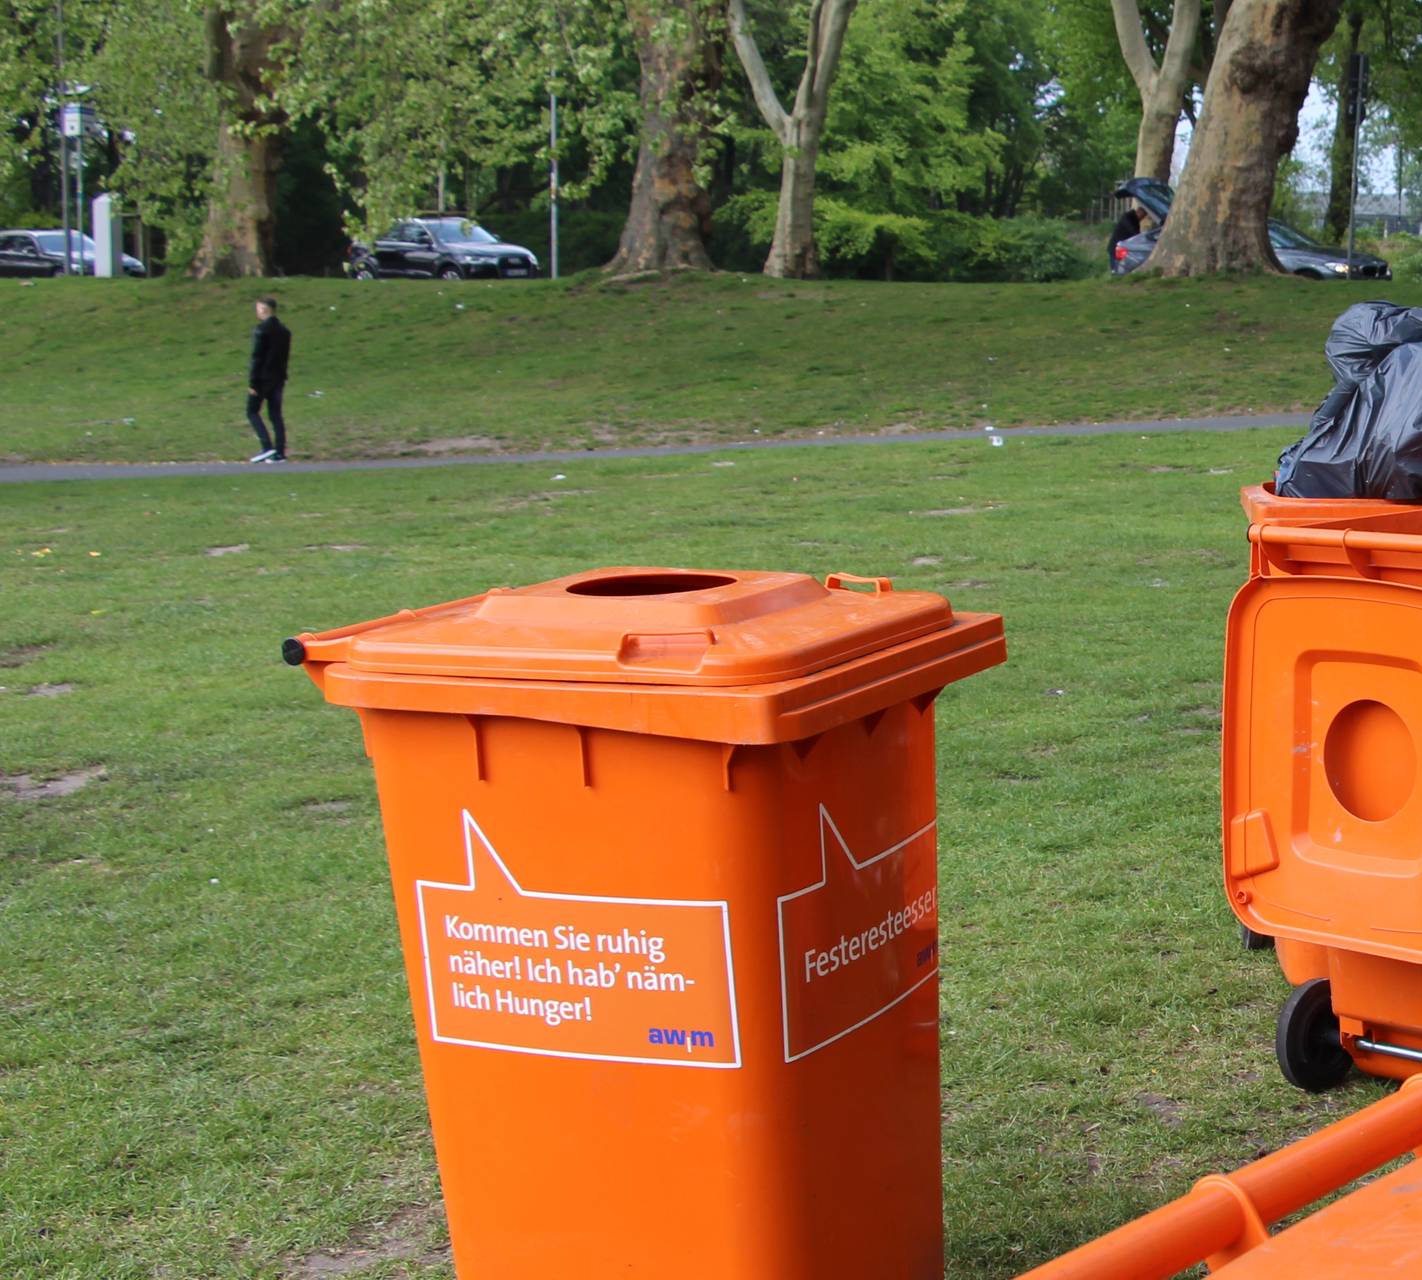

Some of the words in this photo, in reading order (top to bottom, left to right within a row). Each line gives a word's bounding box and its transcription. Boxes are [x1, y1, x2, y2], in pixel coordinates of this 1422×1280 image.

[445, 914, 549, 949] Kommen
[553, 925, 591, 951] Sie
[596, 928, 666, 963] ruhig
[449, 950, 521, 980] näher!
[526, 957, 562, 985] Ich
[626, 965, 696, 992] näm-
[452, 982, 491, 1011] lich
[495, 988, 593, 1026] Hunger!
